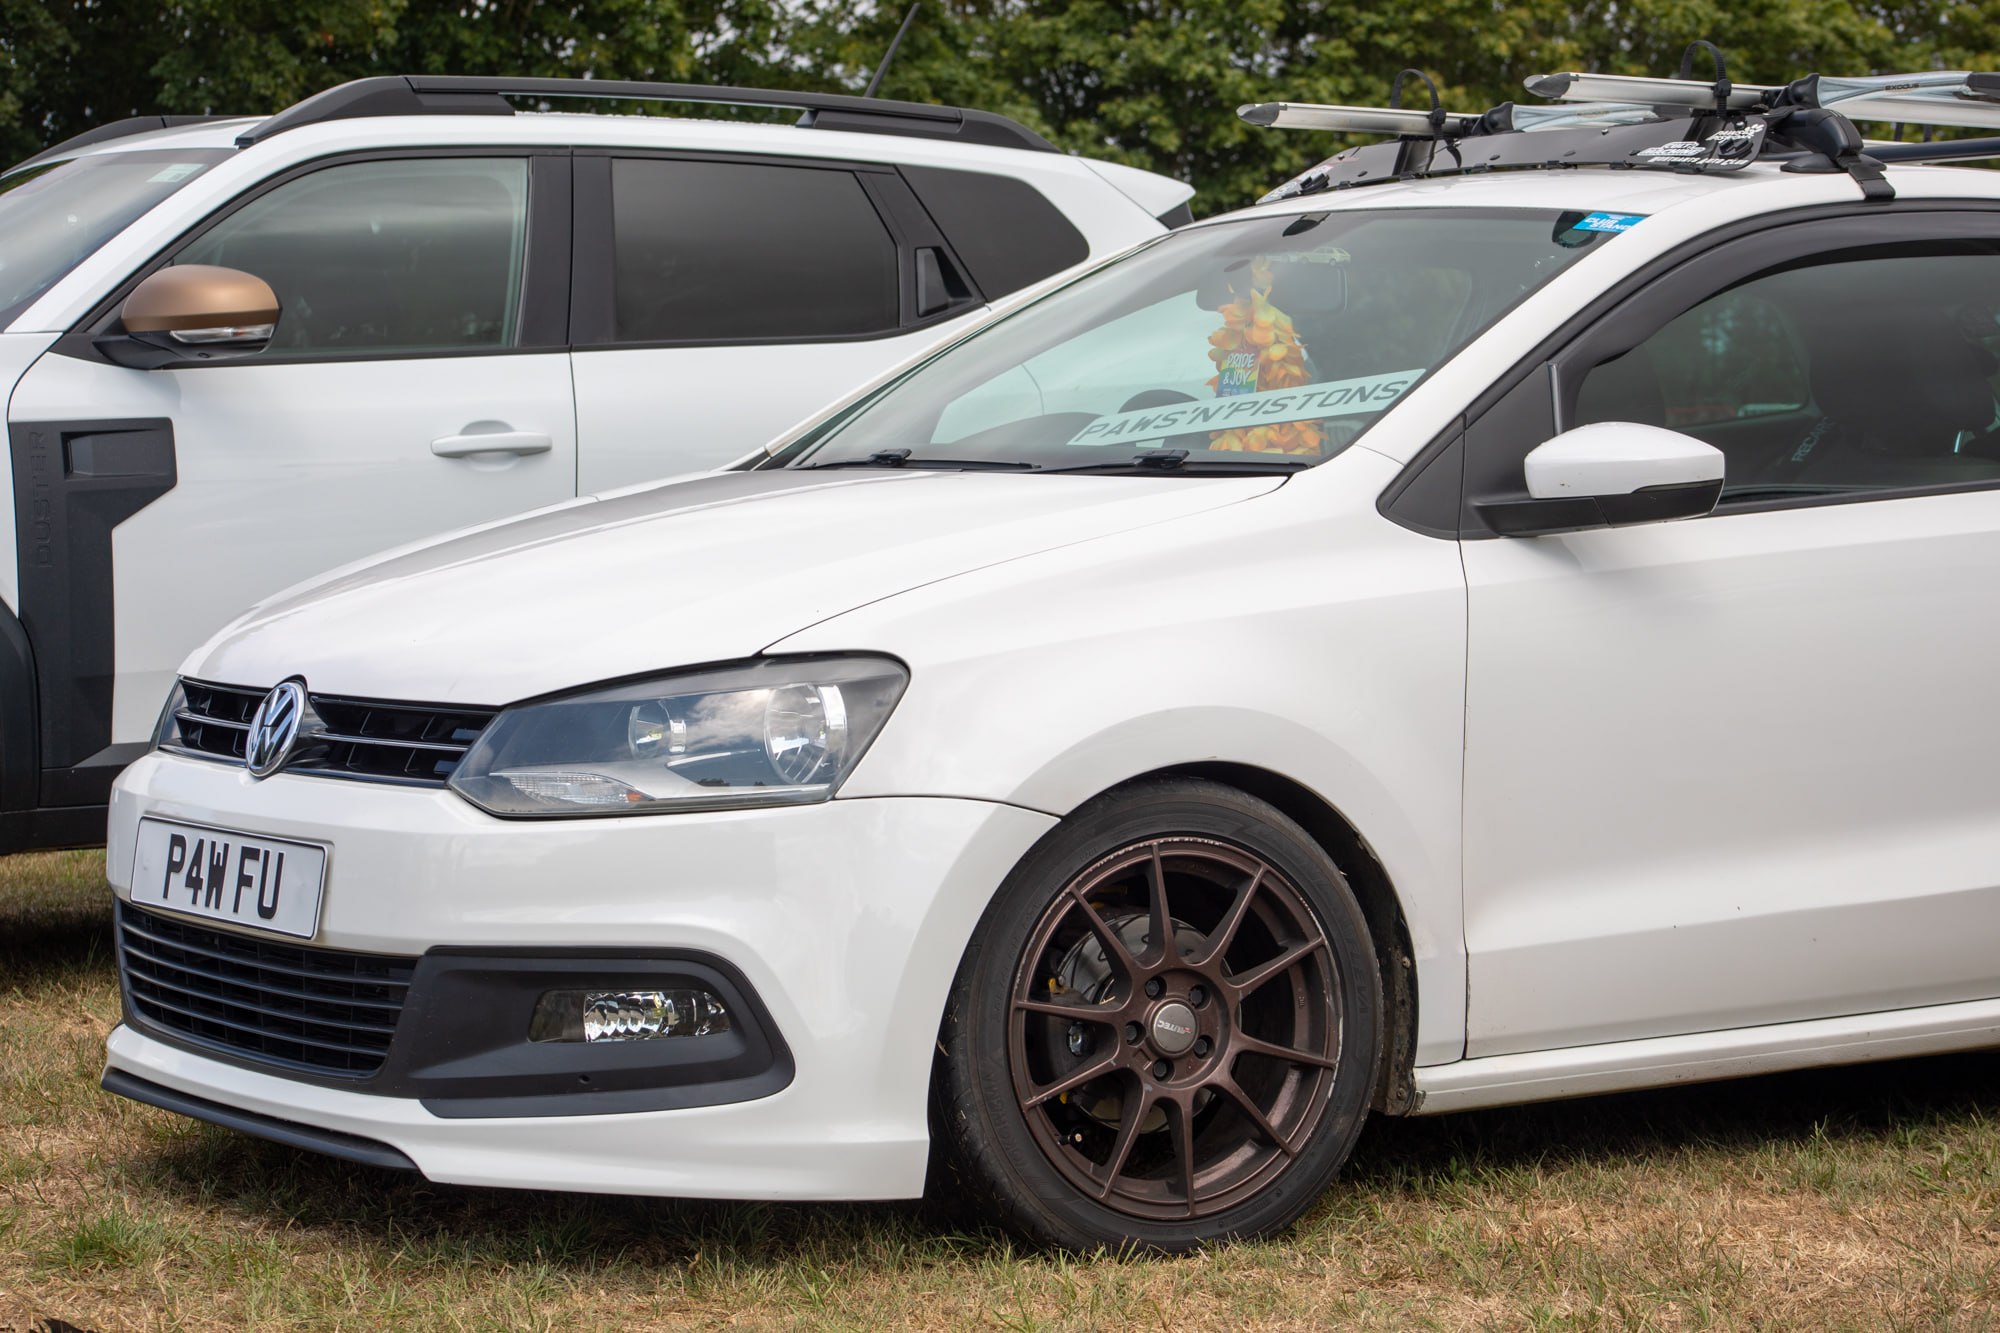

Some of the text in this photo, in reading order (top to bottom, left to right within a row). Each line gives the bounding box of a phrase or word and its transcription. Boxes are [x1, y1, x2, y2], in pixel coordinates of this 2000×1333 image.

[1227, 352, 1255, 369] PRIDE
[28, 431, 53, 568] DUSTER
[162, 832, 285, 920] P4W FU
